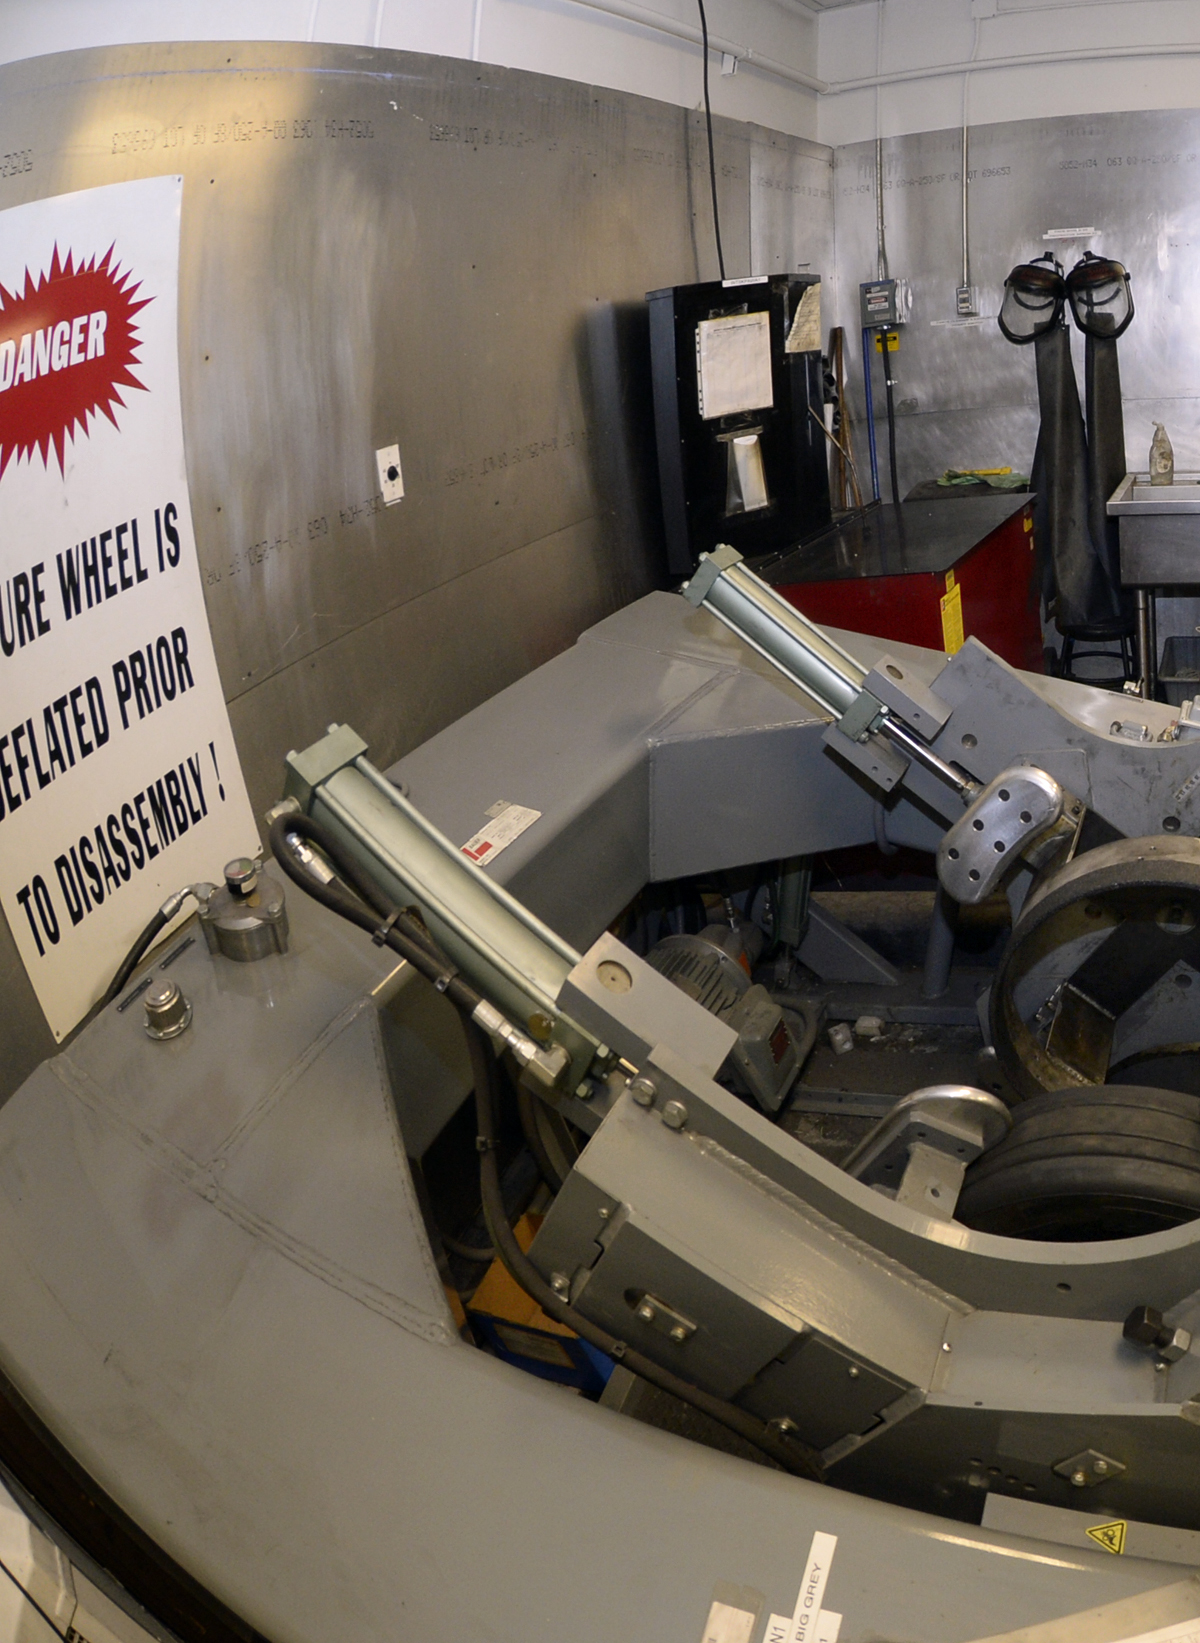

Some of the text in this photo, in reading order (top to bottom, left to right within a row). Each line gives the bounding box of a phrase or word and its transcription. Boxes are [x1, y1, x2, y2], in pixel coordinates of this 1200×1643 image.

[0, 310, 108, 392] DANGER
[56, 517, 149, 623] WHEEL
[154, 501, 181, 574] IS
[0, 626, 196, 823] EFLATED PRIOR
[16, 874, 61, 958] TO
[54, 751, 209, 928] DISASSEMBLY
[795, 1562, 822, 1642] BIG GREY
